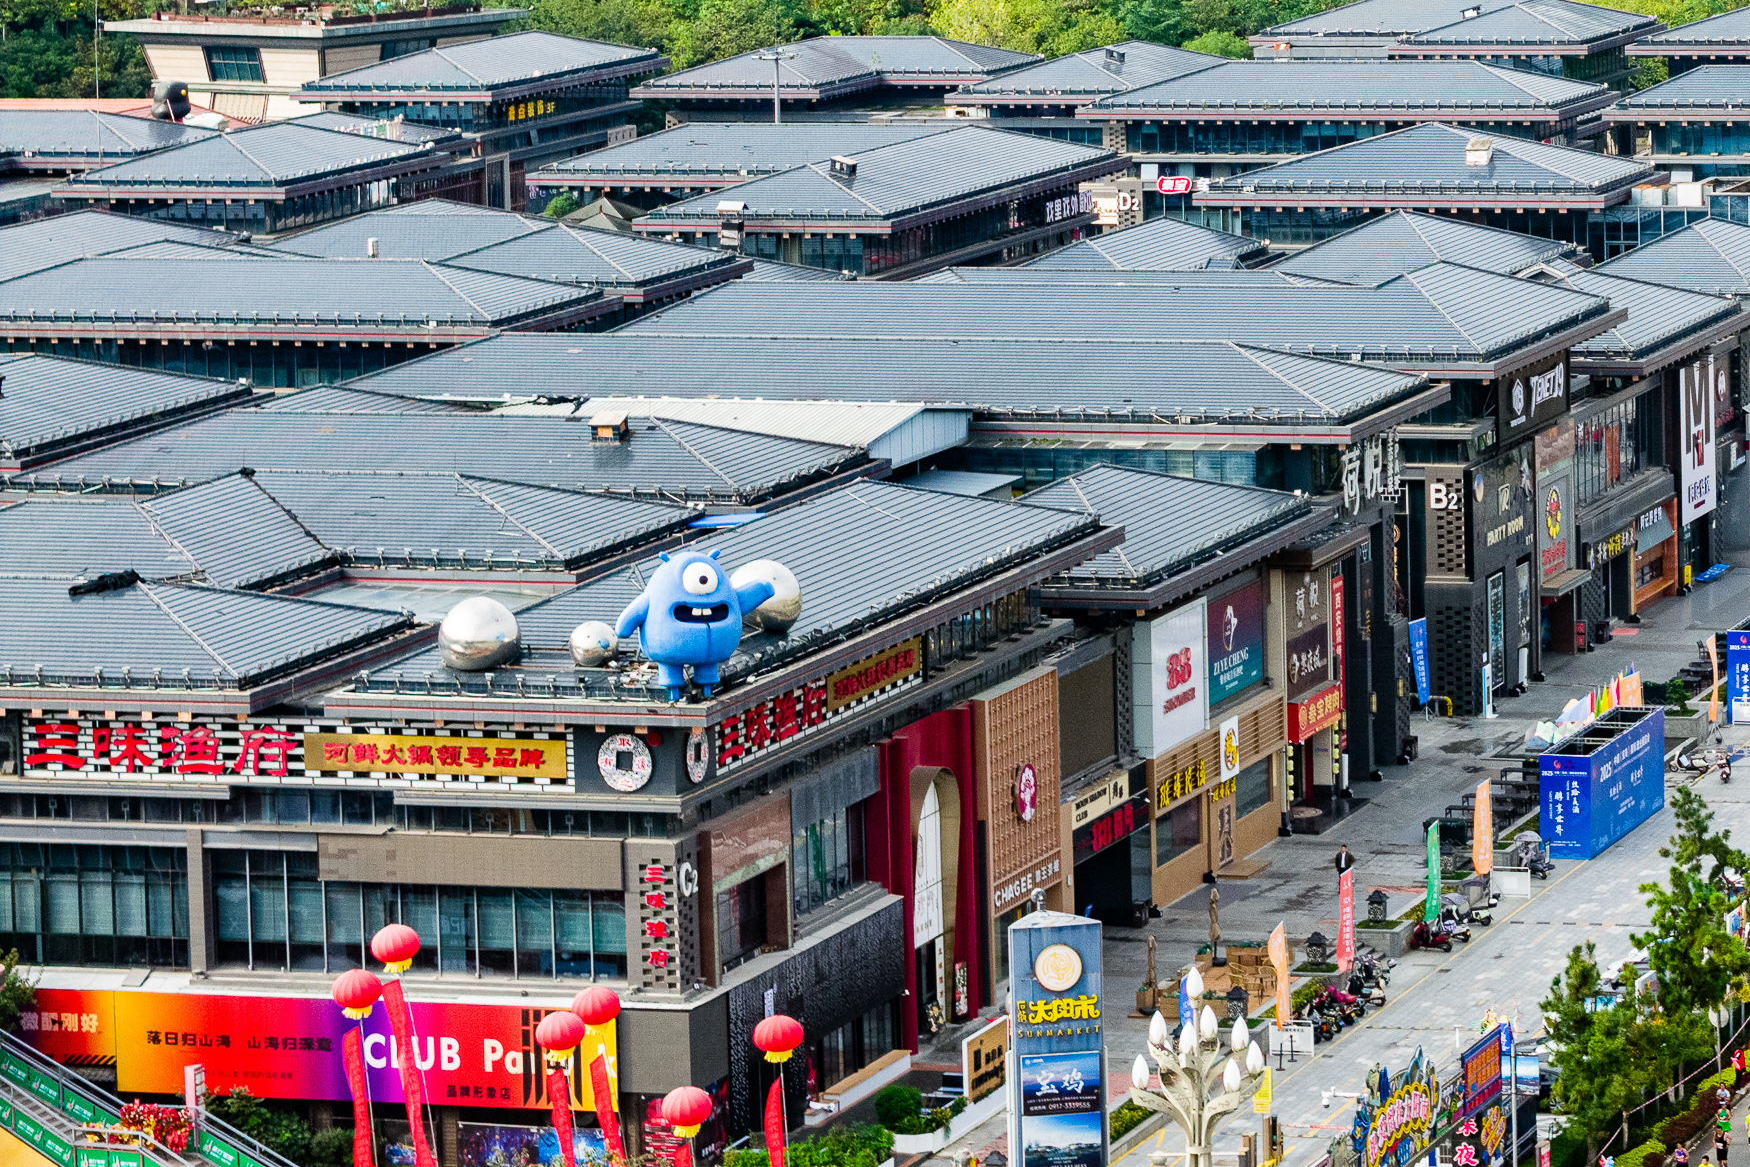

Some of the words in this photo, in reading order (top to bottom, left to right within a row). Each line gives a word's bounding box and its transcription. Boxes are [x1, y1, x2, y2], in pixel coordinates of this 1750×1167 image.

[1119, 192, 1140, 211] D2
[1430, 483, 1458, 510] B2
[1487, 522, 1507, 547] PARTY
[1507, 514, 1524, 537] ROOM
[26, 722, 299, 777] 三味渔府
[323, 742, 547, 770] 河鲜大锅领导品牌
[1600, 761, 1613, 783] 2025
[679, 861, 700, 898] C2
[994, 872, 1033, 908] CHAGEE
[146, 1030, 232, 1049] 落日归山海
[1018, 1024, 1100, 1039] SUNMARKET
[446, 1085, 511, 1101] 品牌形象店
[1035, 1067, 1085, 1097] 宝鸡
